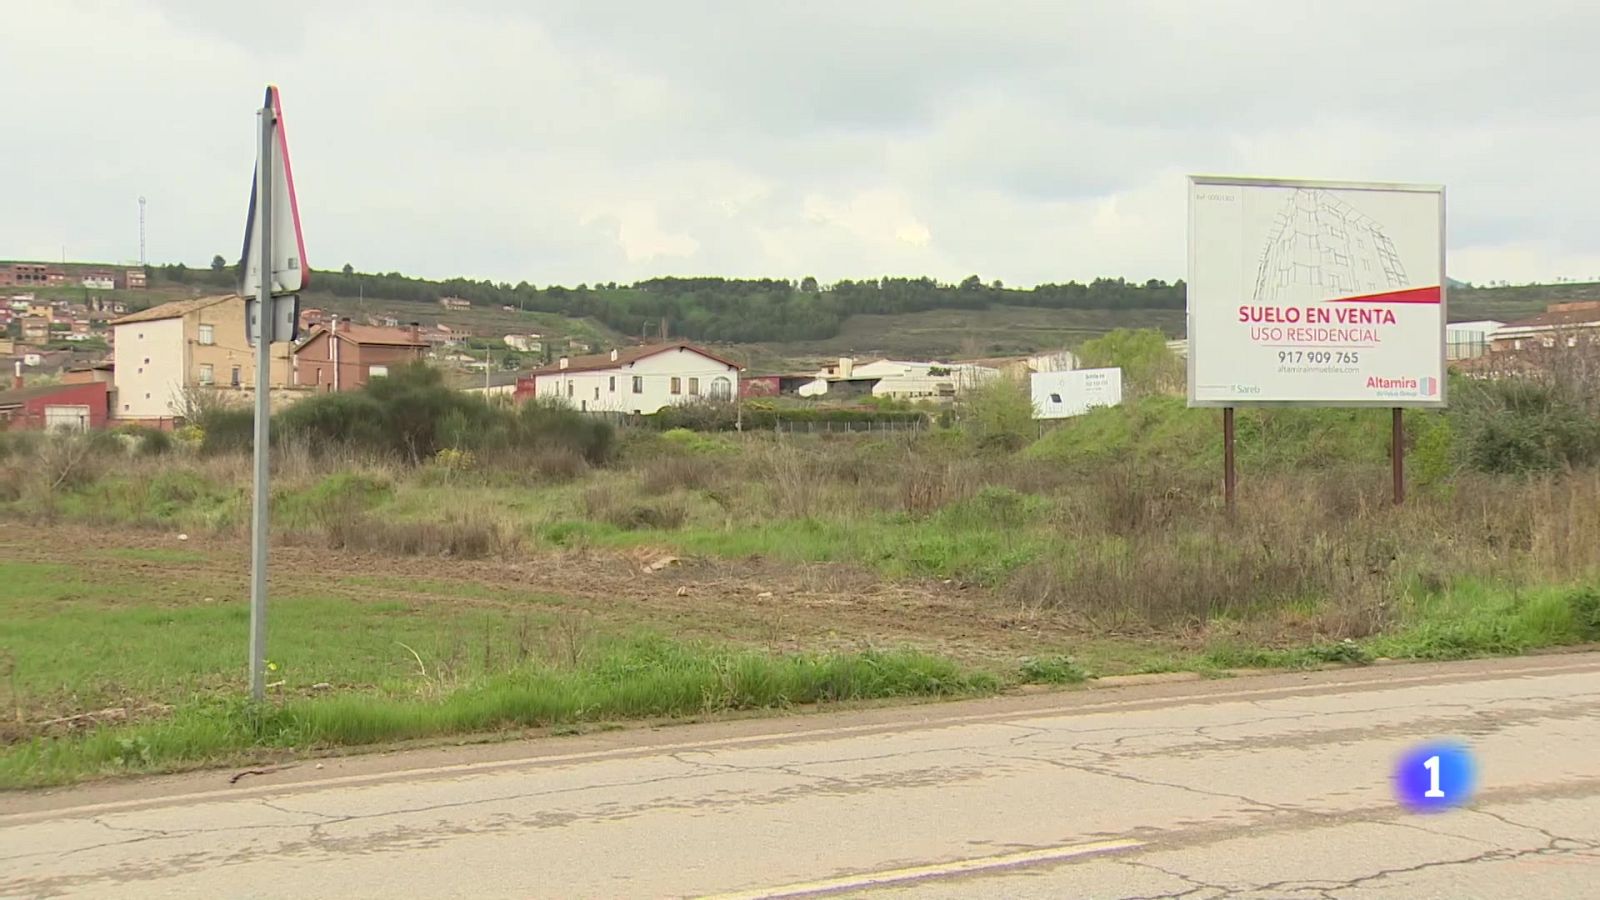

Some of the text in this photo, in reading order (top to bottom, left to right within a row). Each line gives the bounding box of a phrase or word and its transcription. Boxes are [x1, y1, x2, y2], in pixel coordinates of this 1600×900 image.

[1239, 306, 1396, 324] SUELO EN VENTA
[1250, 328, 1381, 342] USO RESIDENCIAL
[1278, 351, 1359, 364] 917 909 765
[1366, 376, 1417, 388] Altamira
